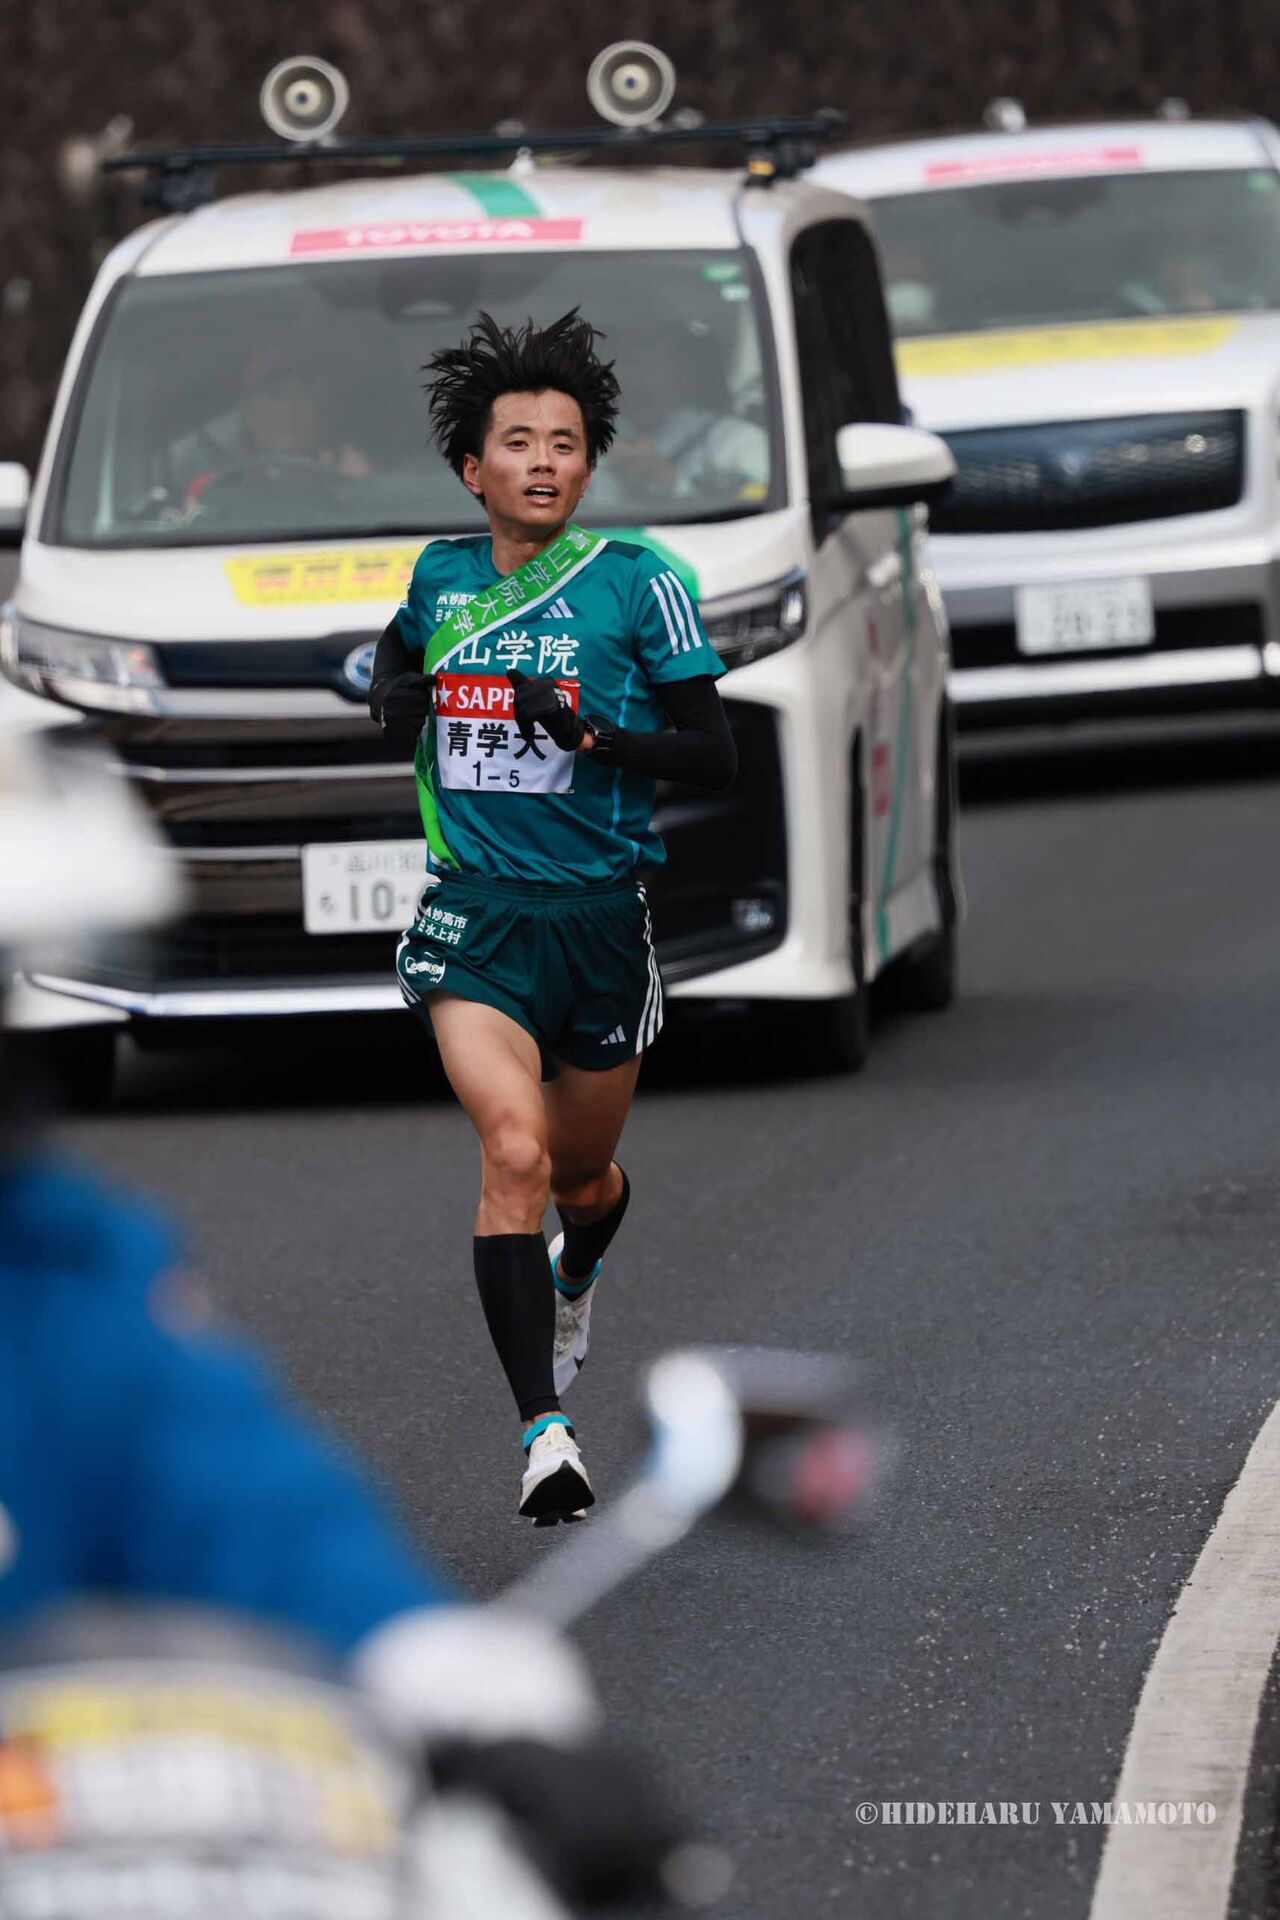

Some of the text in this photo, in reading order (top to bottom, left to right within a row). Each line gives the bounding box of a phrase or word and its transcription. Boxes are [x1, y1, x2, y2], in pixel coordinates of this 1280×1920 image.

[453, 530, 591, 636] 青山学院大学
[442, 630, 580, 676] 山学院
[447, 721, 549, 761] 青学大
[426, 923, 461, 945] 水上村
[432, 907, 468, 929] 妙高市
